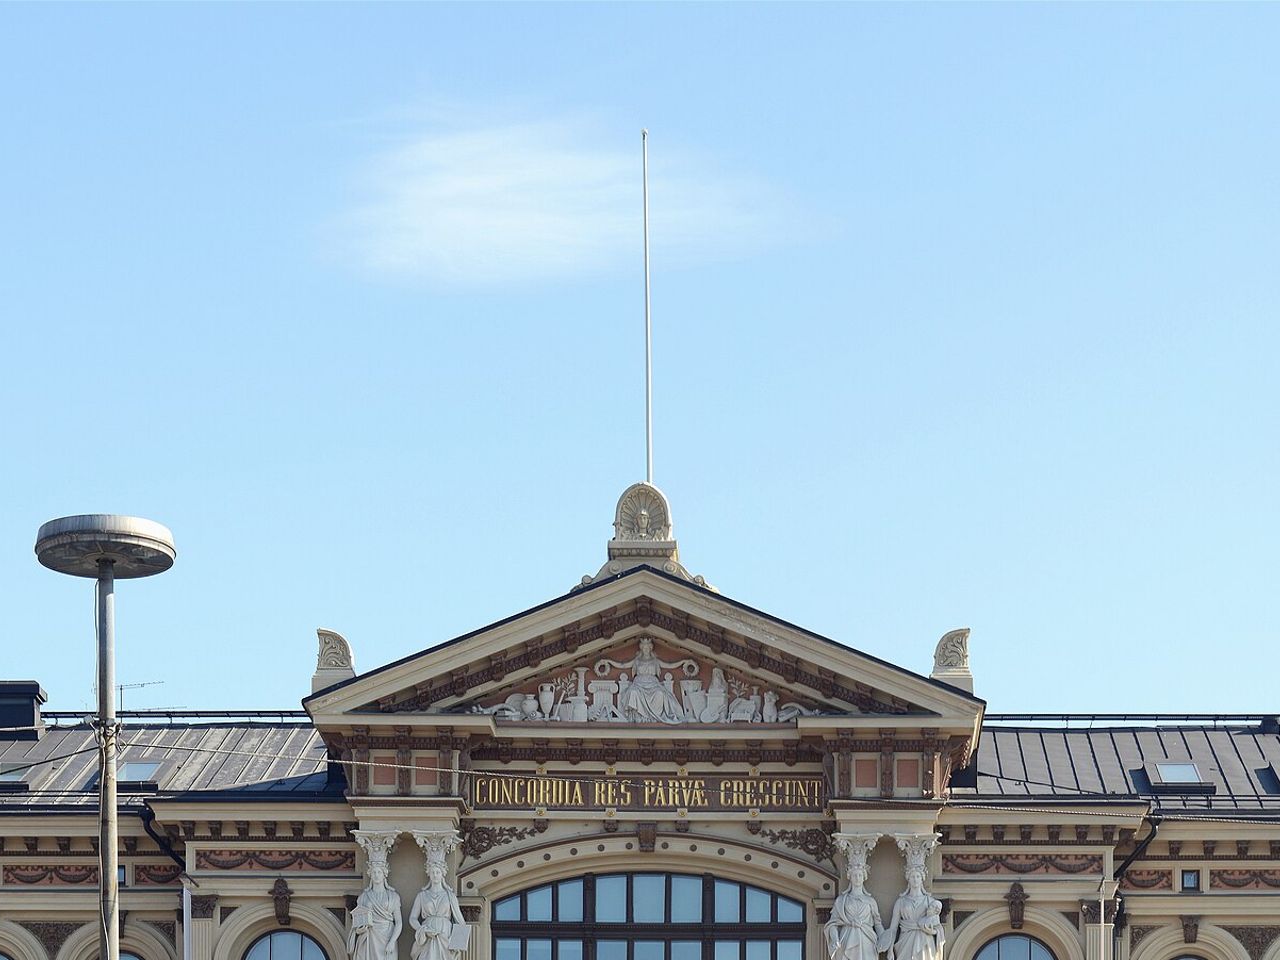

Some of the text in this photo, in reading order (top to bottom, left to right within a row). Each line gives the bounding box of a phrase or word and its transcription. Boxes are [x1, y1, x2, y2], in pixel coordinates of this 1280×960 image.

[475, 778, 823, 808] CONCORDIA RES PARVÆ CRESCUNT
